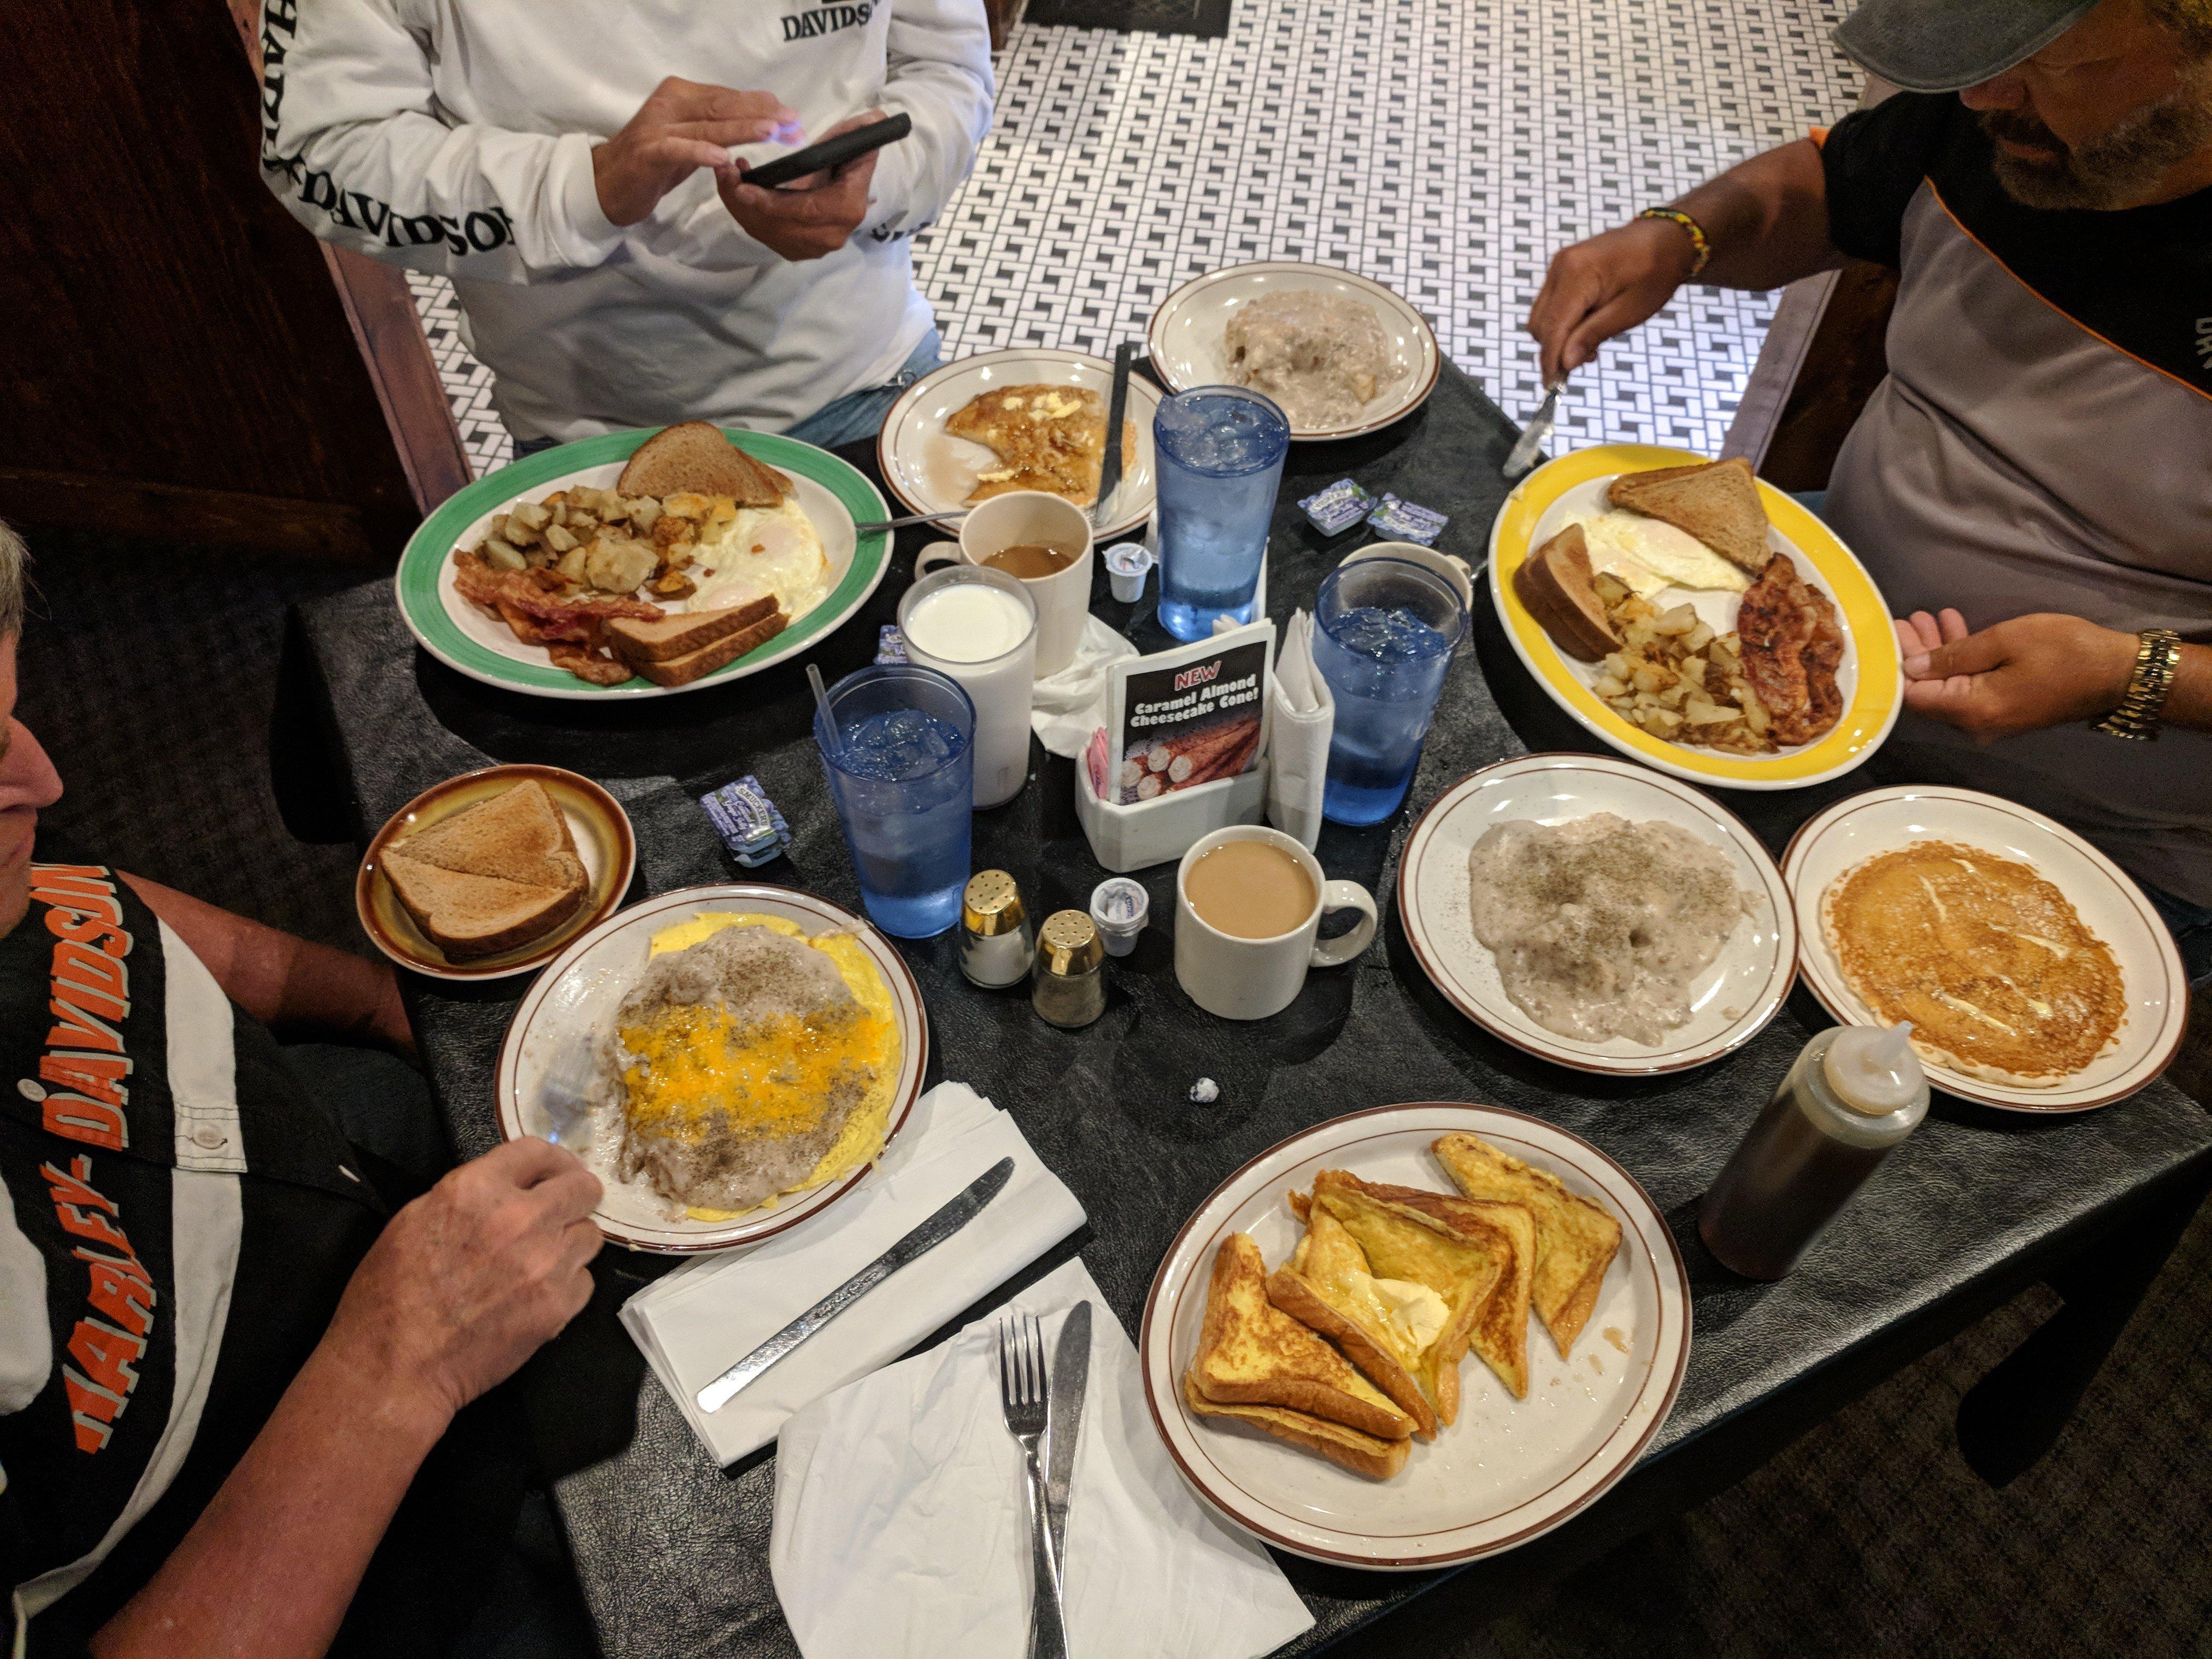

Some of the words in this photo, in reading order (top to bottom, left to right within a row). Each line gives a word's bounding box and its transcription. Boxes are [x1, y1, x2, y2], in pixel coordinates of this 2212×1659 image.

[1135, 692, 1197, 715] Caramel
[1200, 673, 1256, 701] Almond
[1175, 660, 1222, 691] NEW
[1131, 702, 1215, 727] Cheesecake
[1220, 687, 1258, 708] Cone!
